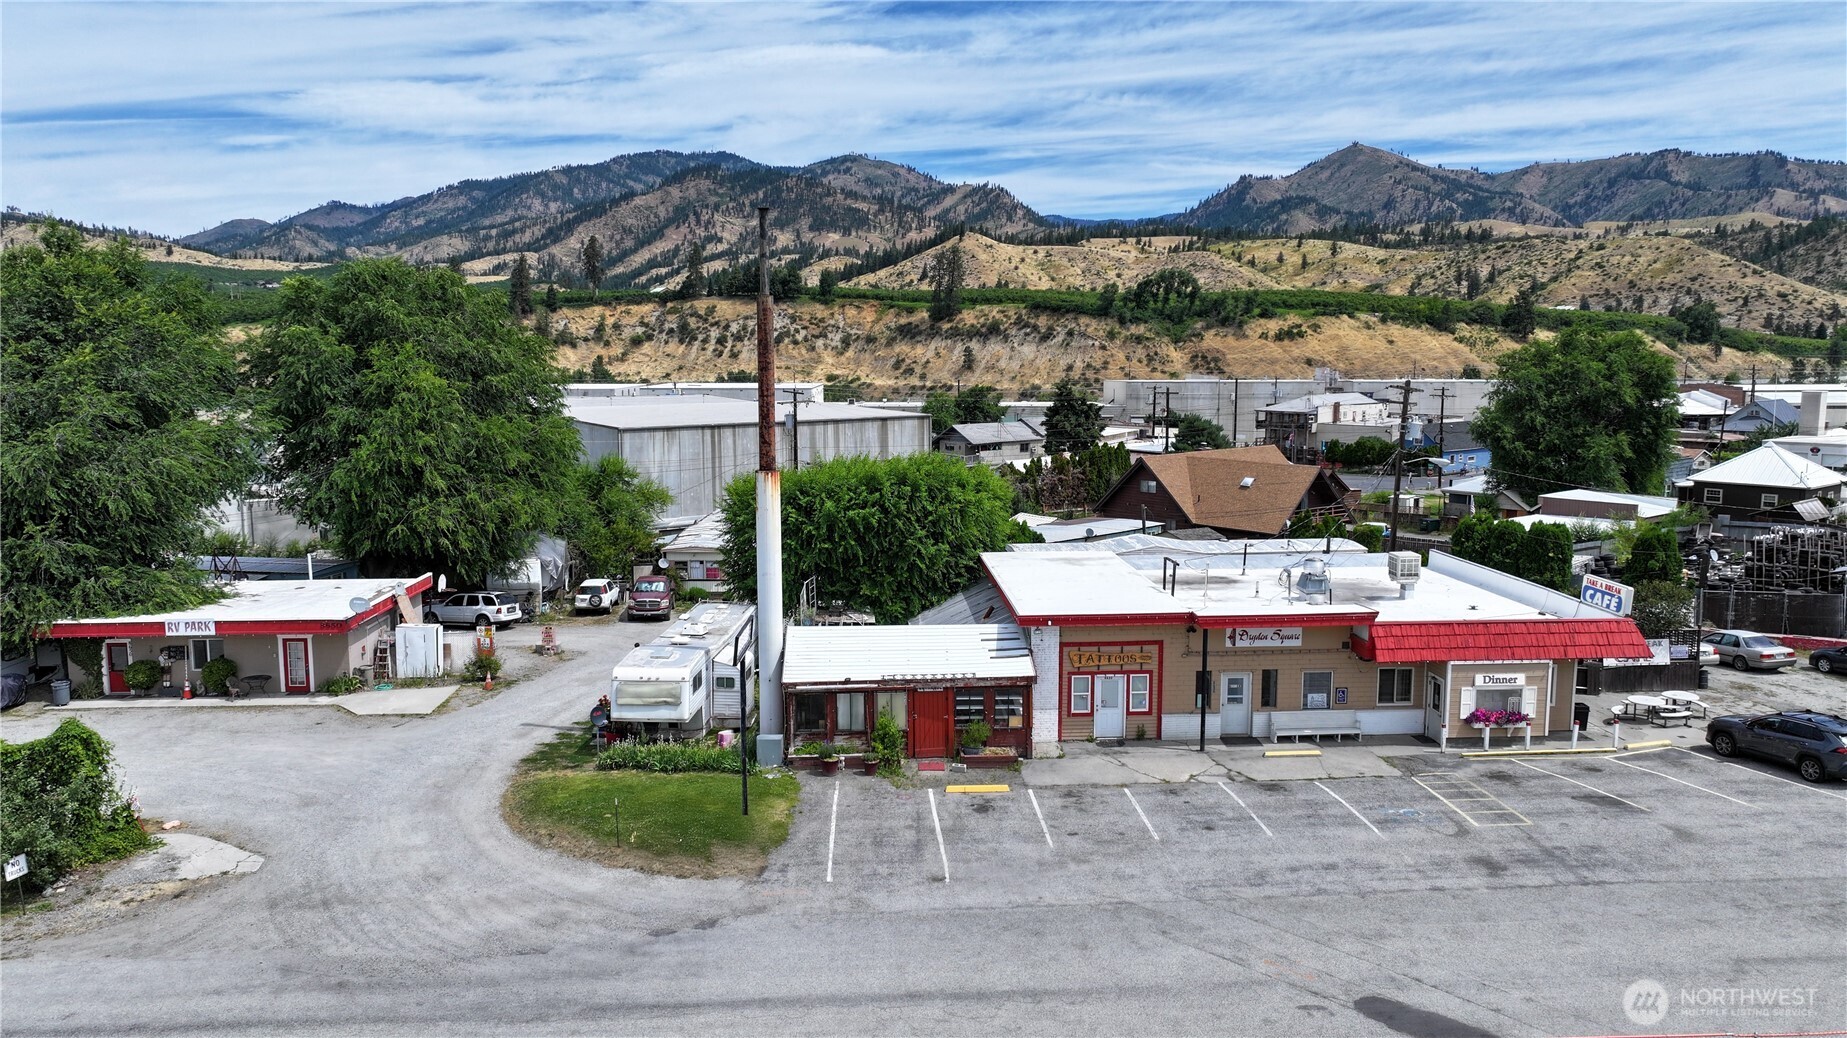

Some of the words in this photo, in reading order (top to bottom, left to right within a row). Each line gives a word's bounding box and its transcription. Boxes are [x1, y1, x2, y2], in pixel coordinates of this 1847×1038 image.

[1586, 578, 1598, 587] TAKE
[1605, 584, 1622, 595] BREAK
[1585, 589, 1619, 611] CAFÉ
[167, 621, 180, 633] RV
[184, 620, 211, 633] PARK
[1238, 629, 1268, 645] Dryden
[1270, 629, 1301, 644] Square
[1074, 653, 1137, 664] TATTOOS
[1483, 675, 1518, 685] Dinner
[11, 859, 20, 869] NO
